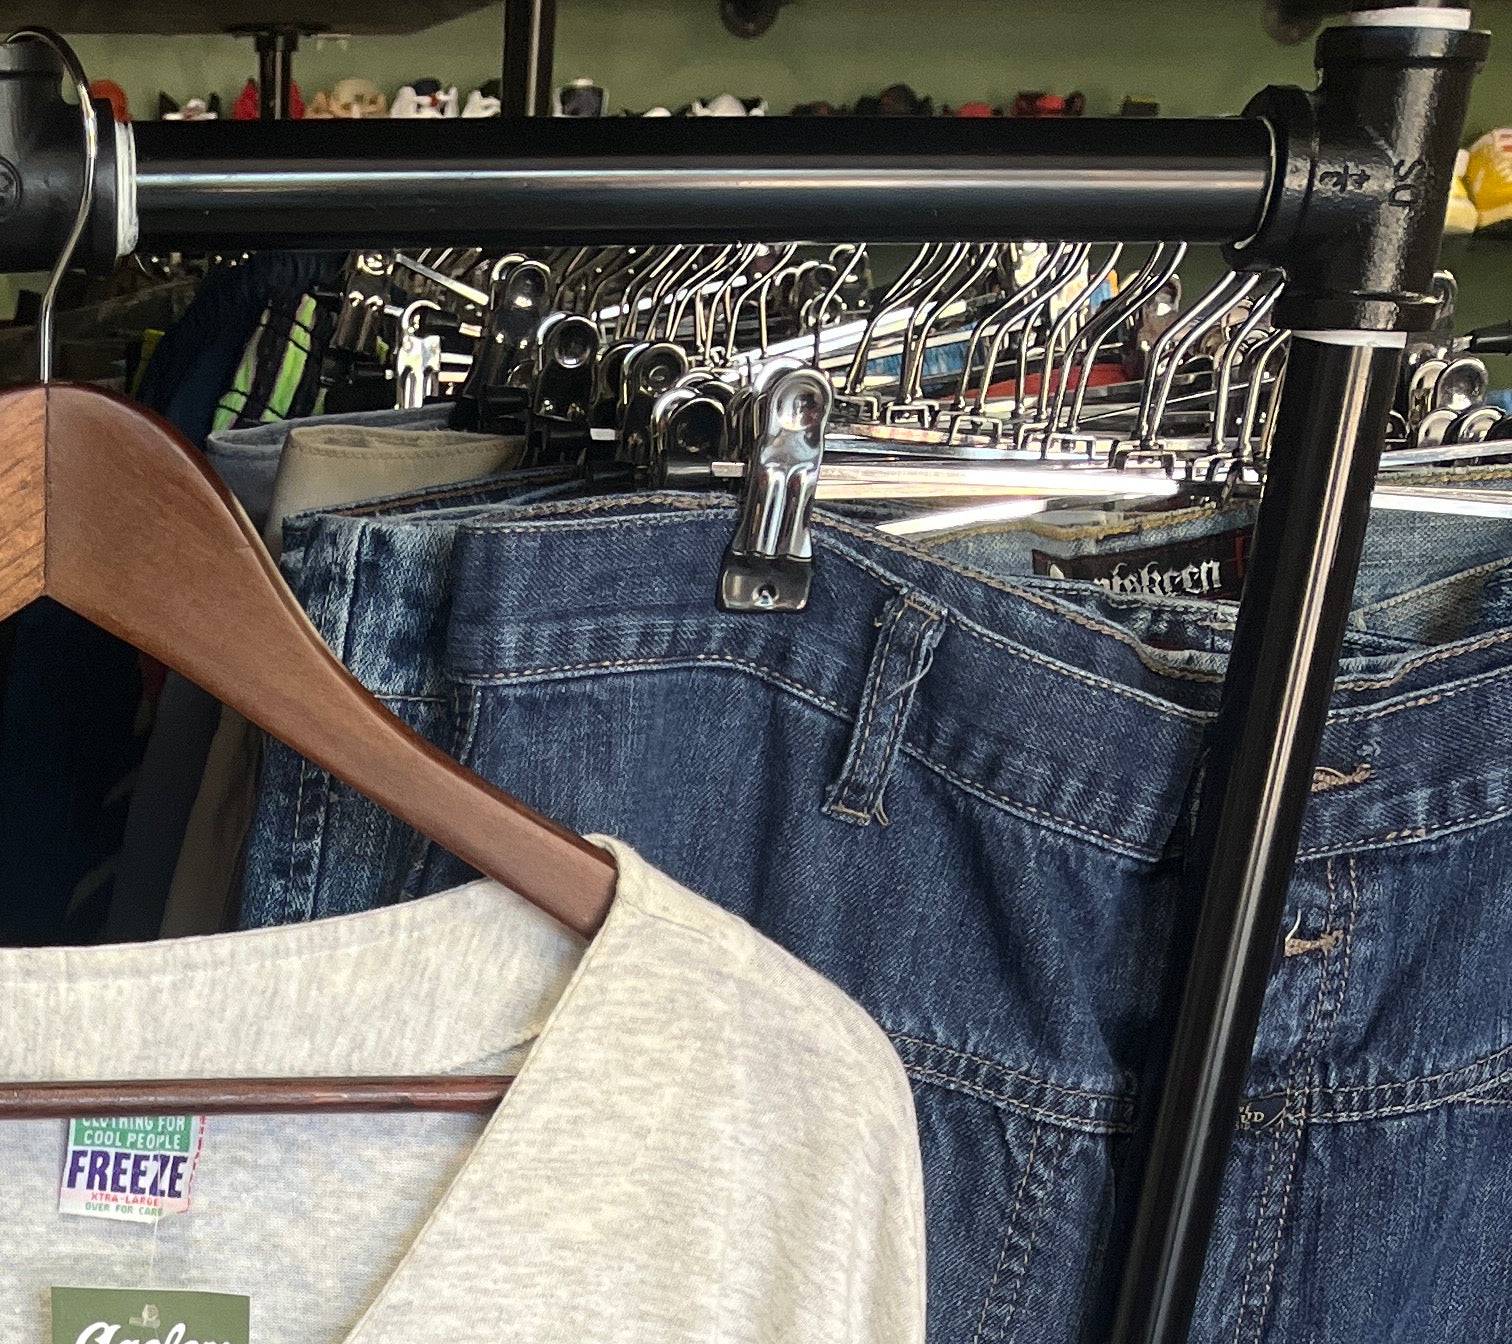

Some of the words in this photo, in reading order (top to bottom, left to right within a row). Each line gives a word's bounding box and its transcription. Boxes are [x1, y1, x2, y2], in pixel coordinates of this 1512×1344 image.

[158, 1116, 186, 1132] FOR
[84, 1130, 122, 1147] COOL
[126, 1132, 182, 1150] PEOPLE
[66, 1149, 188, 1199] FREEZE
[115, 1204, 134, 1214] FOR
